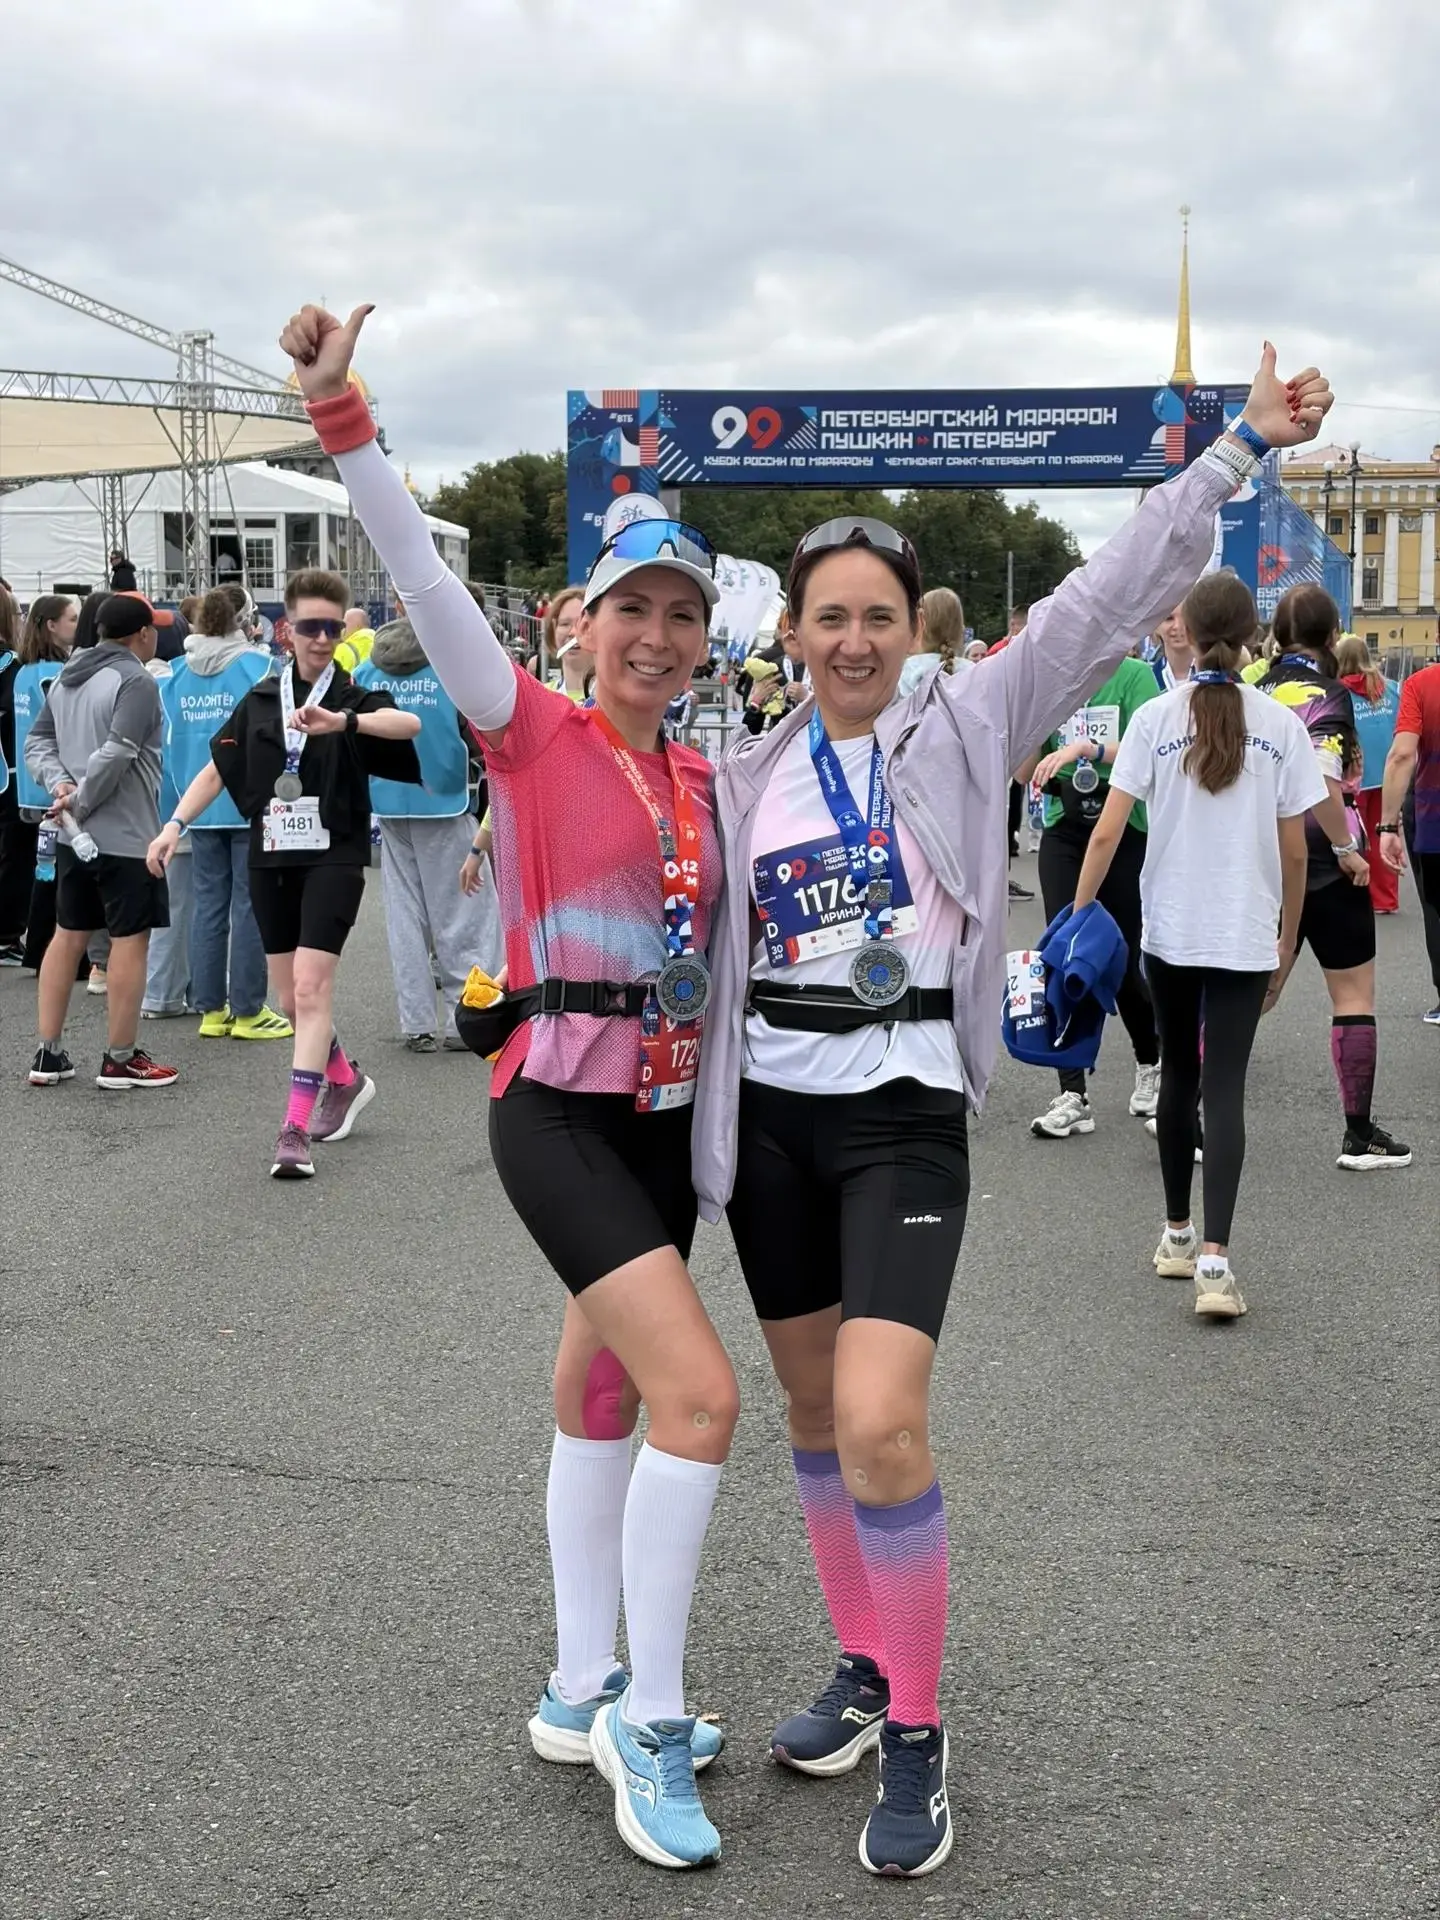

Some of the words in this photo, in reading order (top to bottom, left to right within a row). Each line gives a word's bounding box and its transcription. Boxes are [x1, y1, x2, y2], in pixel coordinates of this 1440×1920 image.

[1200, 391, 1218, 400] ВТБ
[616, 414, 634, 423] ВТБ
[821, 405, 999, 428] ПЕТЕРБУРГСКИЙ
[1006, 407, 1118, 427] МАРАФОН
[711, 406, 782, 450] 99
[821, 432, 914, 450] ПУШКИН
[933, 430, 1057, 449] ПЕТЕРБУРГ
[704, 456, 741, 467] КУБОК
[743, 456, 788, 467] РОССИИ
[790, 456, 806, 467] ПО
[809, 456, 874, 467] МАРАФОНУ
[884, 456, 944, 467] ЧЕМПИОНАТ
[946, 455, 1046, 467] САНКТ-ПЕТЕРБУРГА
[1048, 455, 1062, 466] ПО
[1065, 454, 1124, 465] МАРАФОНУ
[371, 677, 438, 693] ВОЛОНТЁР
[181, 692, 235, 708] ВОЛОНТЁР
[281, 817, 313, 830] 1481
[776, 858, 807, 884] 99
[793, 874, 858, 916] 1176
[820, 905, 862, 925] ИРИНА
[766, 922, 779, 939] D
[771, 944, 784, 955] 30
[642, 1066, 653, 1082] D
